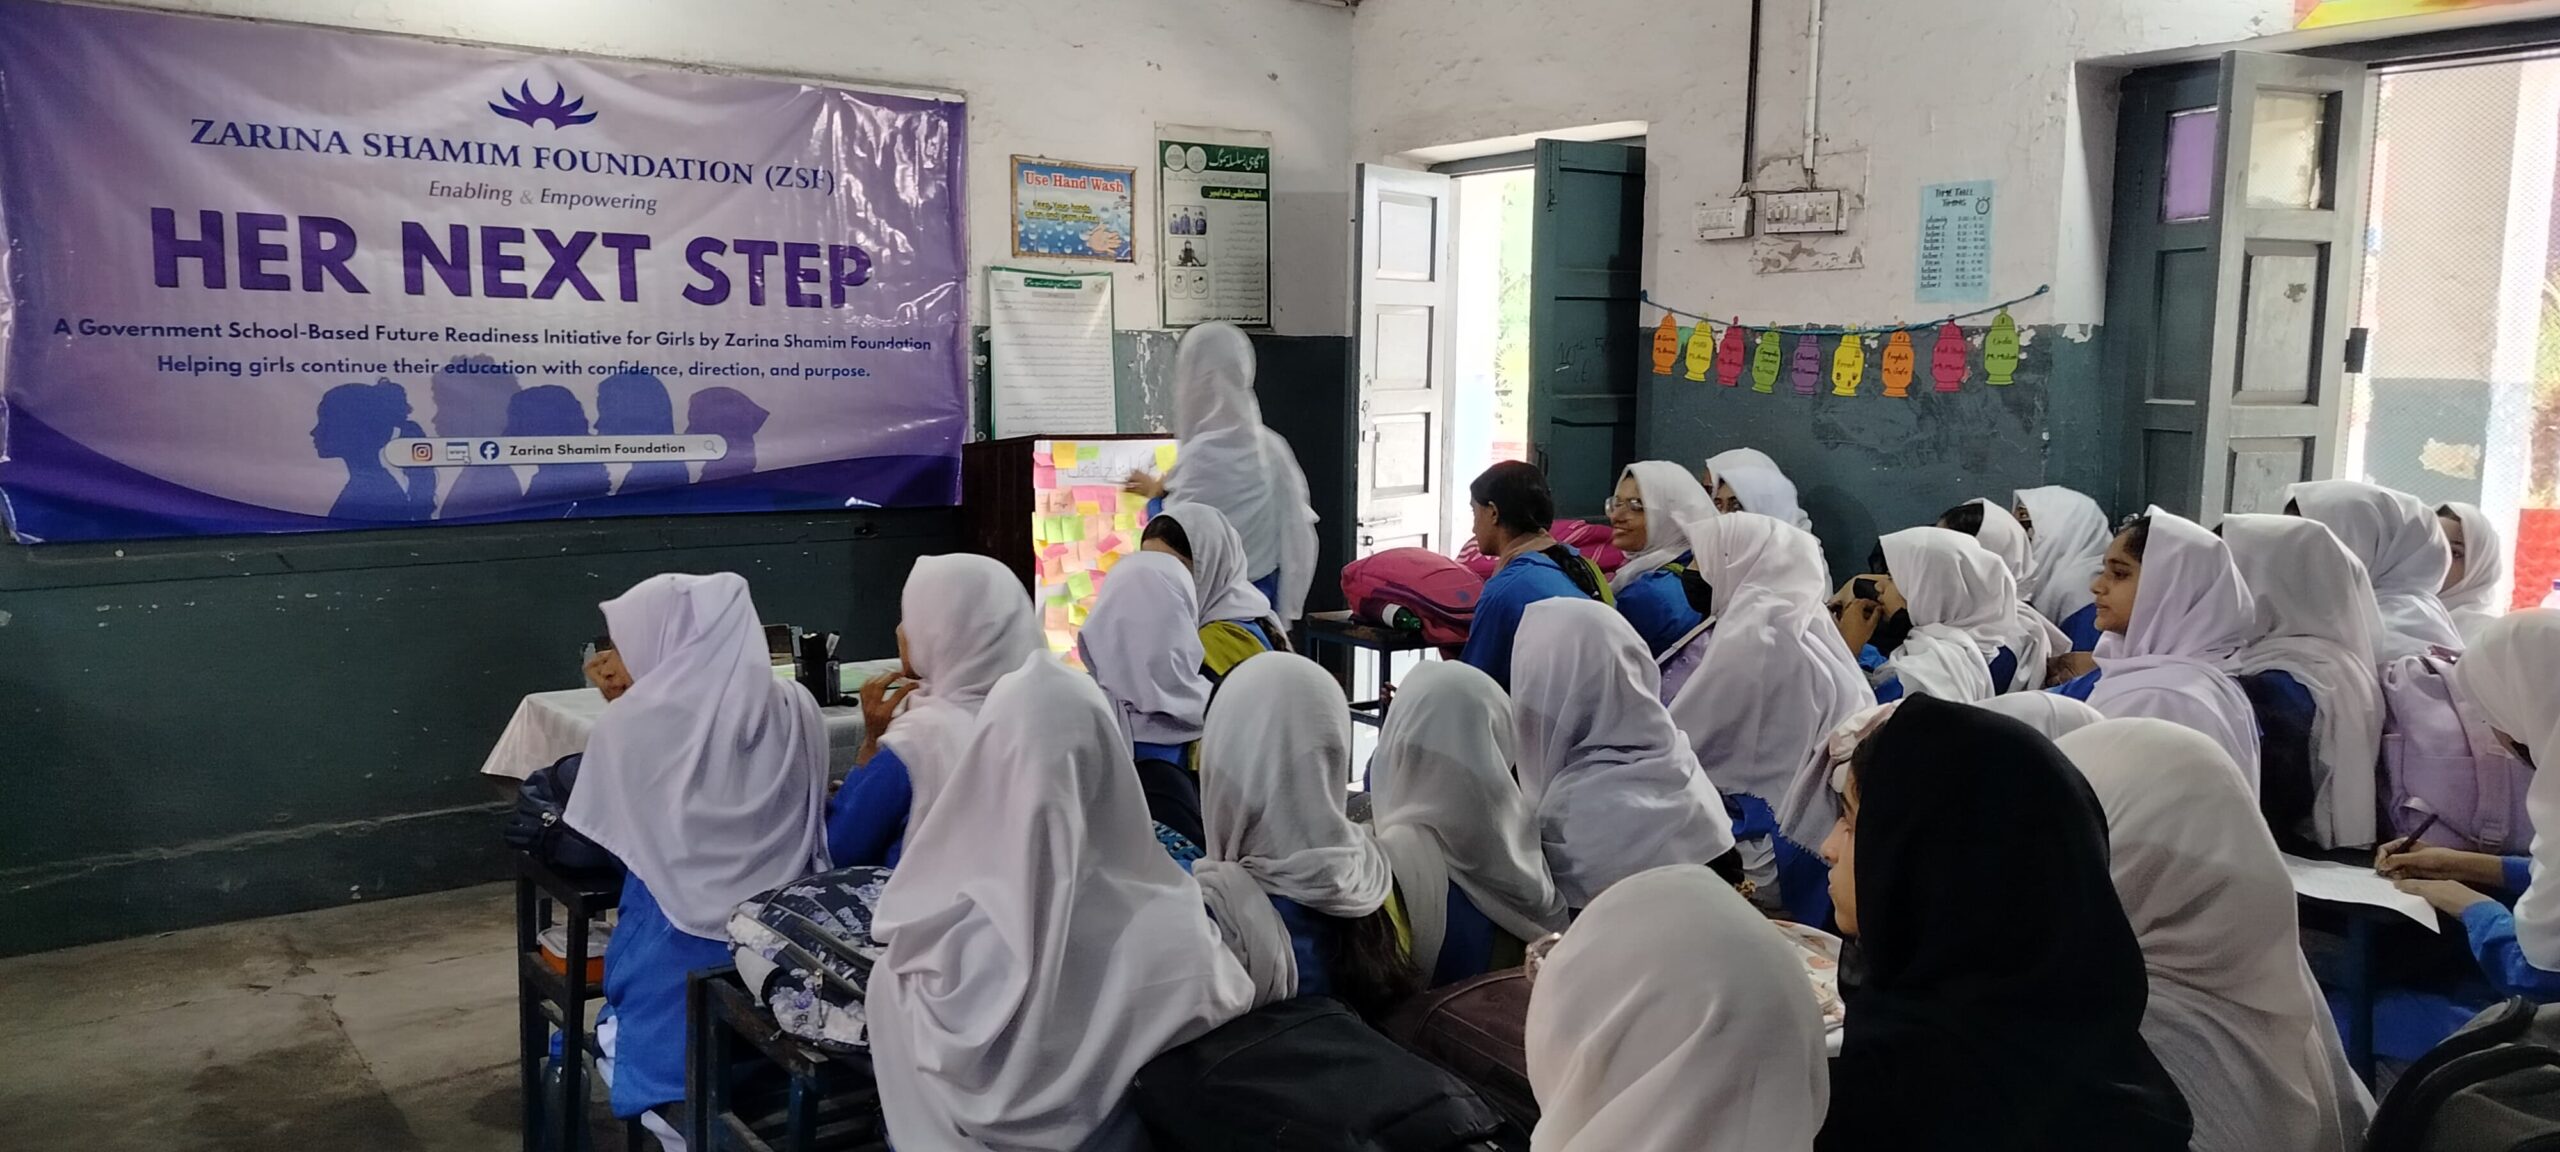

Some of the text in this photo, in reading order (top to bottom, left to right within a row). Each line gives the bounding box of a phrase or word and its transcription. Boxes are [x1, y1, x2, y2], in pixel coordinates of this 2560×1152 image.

[190, 118, 835, 196] ZARINA SHAMIM FOUNDATION (ZSF)
[428, 180, 658, 216] Enabling & Empowering
[1024, 171, 1124, 193] Use Hand Wash
[150, 207, 872, 309] HER NEXT STEP
[53, 318, 932, 351] A Government School-Based Future Readiness Initiative for Girls by Zarina Shamim Foundation
[157, 355, 871, 381] Helping girls continue their education with confidence, direction, and purpose.
[510, 443, 686, 456] Zarina Shamim Foundation
